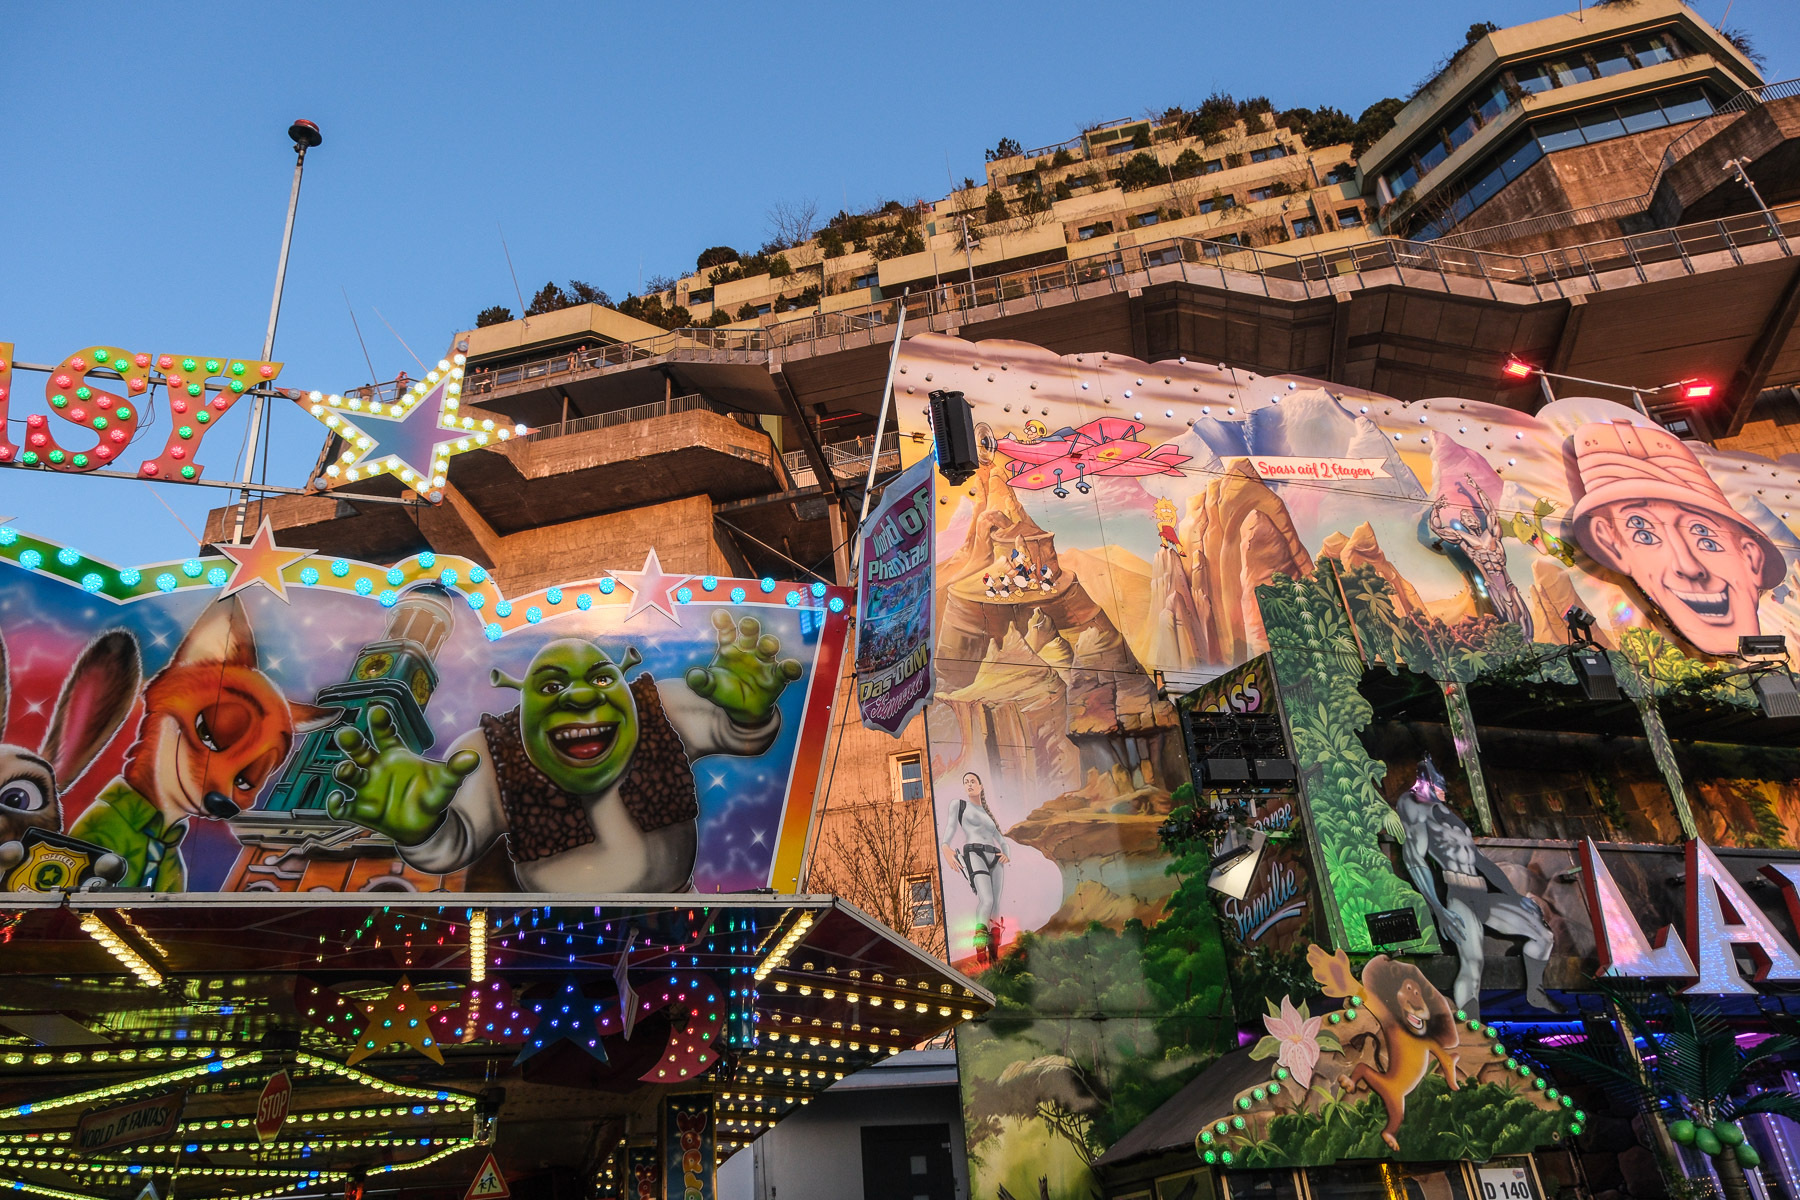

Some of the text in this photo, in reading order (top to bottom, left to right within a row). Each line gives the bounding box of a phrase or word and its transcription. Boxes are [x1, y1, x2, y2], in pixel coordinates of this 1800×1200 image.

[0, 342, 284, 484] SY
[1258, 461, 1295, 476] Spass
[1297, 463, 1318, 478] auf
[1319, 462, 1333, 479] 2
[898, 486, 930, 536] of
[859, 642, 928, 703] Das DOM
[1224, 861, 1298, 943] Familie
[1579, 835, 1800, 995] LA
[79, 1107, 172, 1147] WORLD OF FANTASY
[259, 1089, 288, 1123] STOP
[1483, 1182, 1530, 1200] D 140
